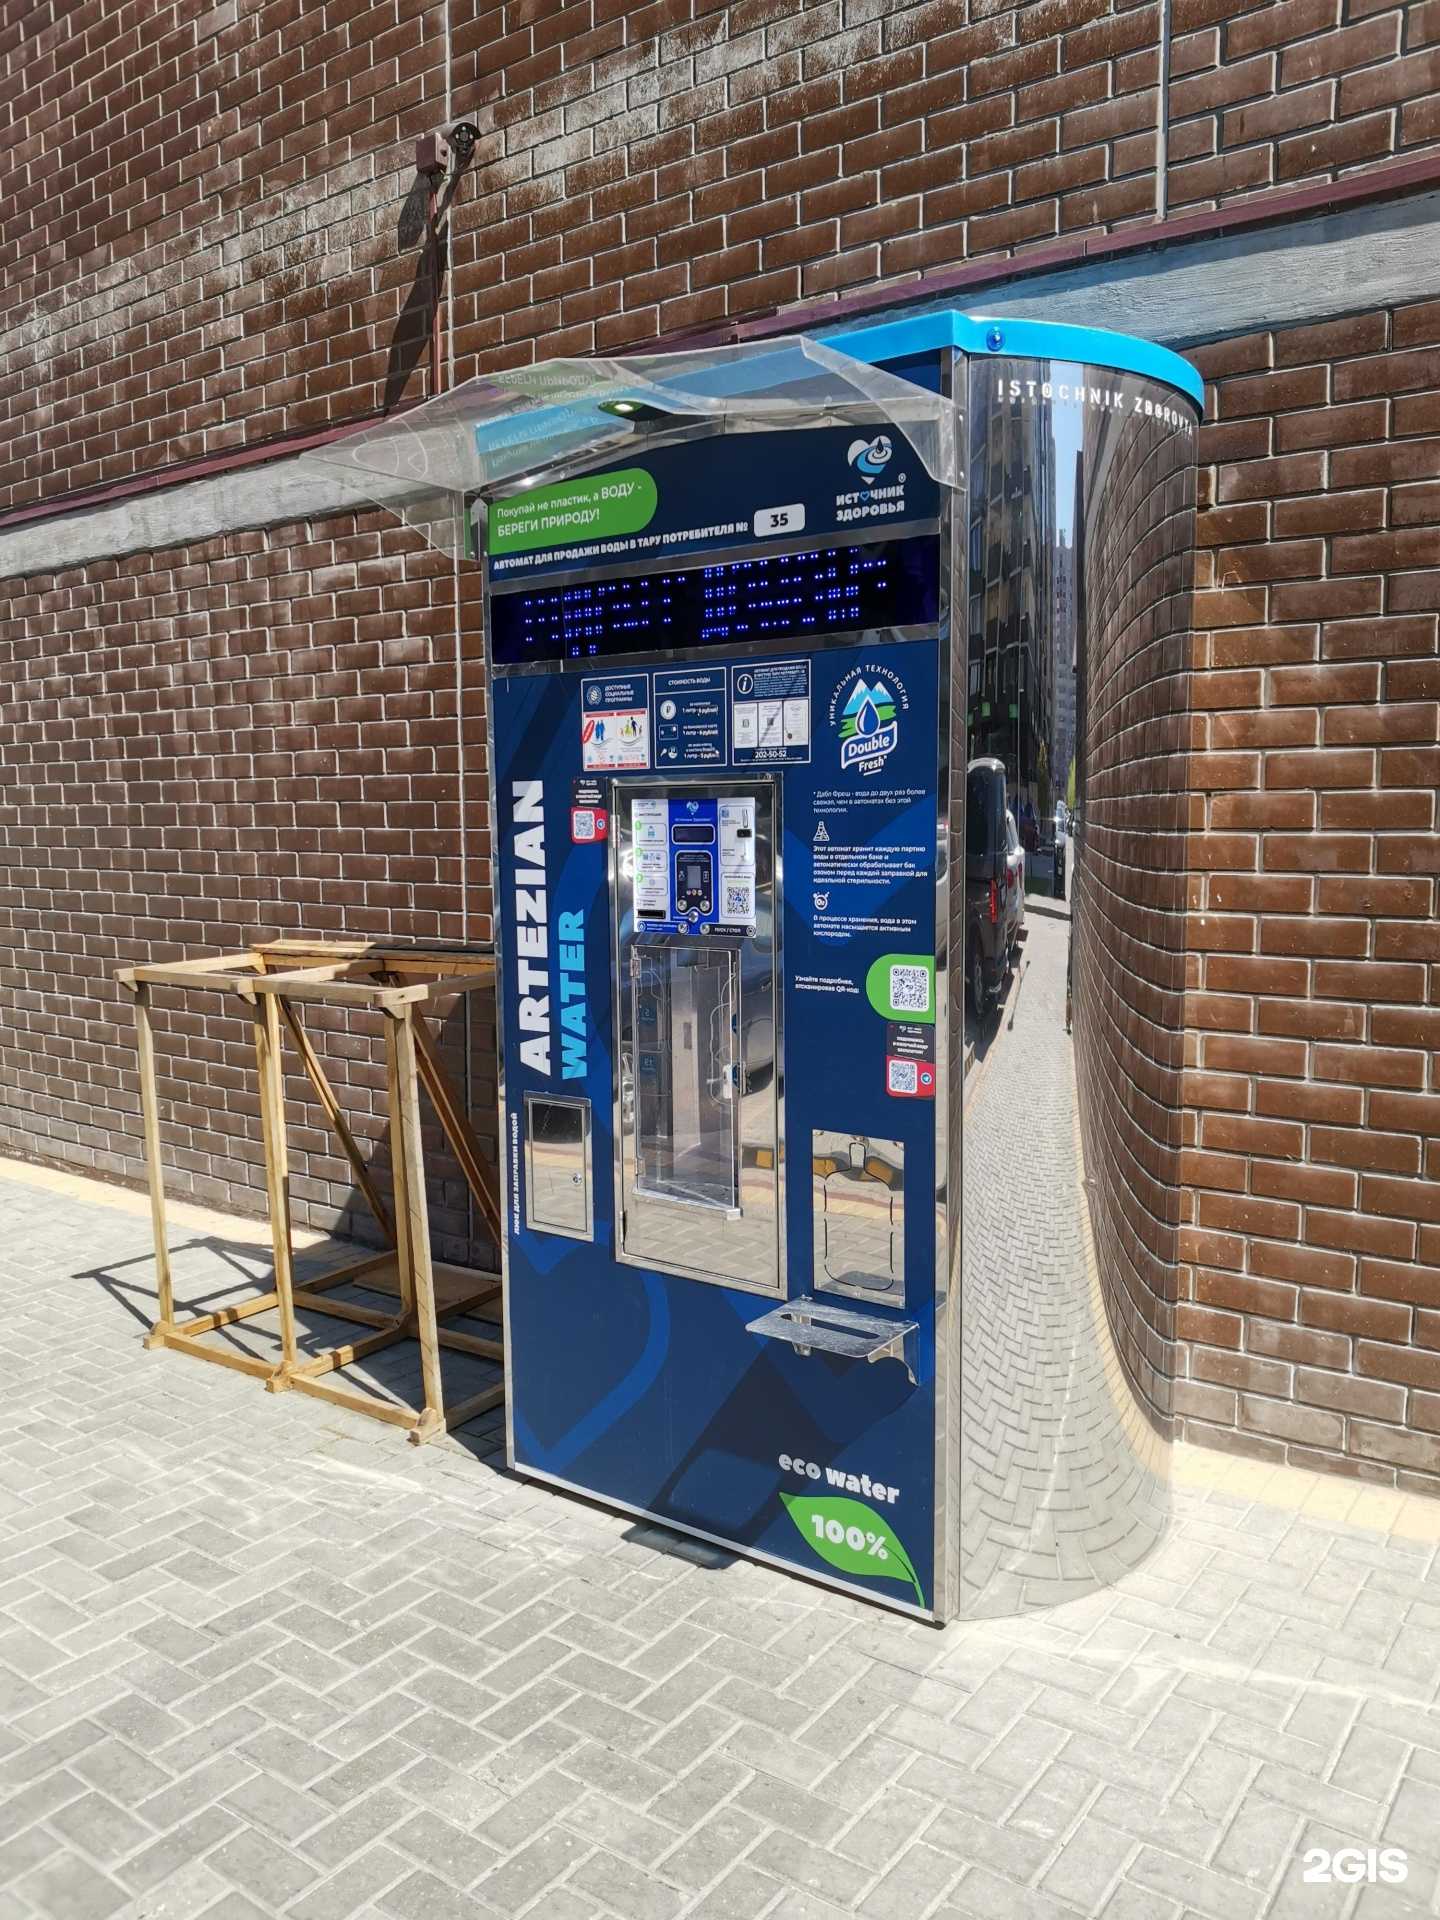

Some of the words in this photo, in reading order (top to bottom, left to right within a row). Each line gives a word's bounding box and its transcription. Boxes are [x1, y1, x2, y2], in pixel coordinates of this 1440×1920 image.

[998, 379, 1124, 409] ISTOCHNIK
[497, 503, 535, 519] Покупай
[537, 503, 549, 511] не
[551, 496, 591, 508] пластик,
[593, 493, 599, 501] а
[601, 482, 635, 500] ВОДУ
[836, 500, 905, 522] ЗДОРОВЬЯ
[494, 557, 534, 570] АВТОМАТ
[535, 553, 552, 565] ДЛЯ
[554, 546, 599, 561] ПРОДАЖИ
[600, 541, 628, 554] ВОДЫ
[630, 539, 636, 549] В
[637, 534, 661, 548] ТАРУ
[662, 523, 734, 544] ПОТРЕБИТЕЛЯ
[735, 522, 748, 532] №
[770, 513, 788, 528] 35
[498, 519, 538, 537] БЕРЕГИ
[541, 508, 600, 528] ПРИРОДУ!
[829, 667, 862, 726] УНИКАЛЬНАЯ
[865, 665, 909, 710] ТЕХНОЛОГИЯ
[848, 735, 890, 757] Double
[512, 780, 551, 1076] ARTEZIAN
[558, 909, 586, 1080] WATER
[510, 1112, 518, 1145] ВОДОЙ
[778, 1453, 821, 1480] eco
[825, 1467, 900, 1504] water
[811, 1514, 888, 1560] 100%
